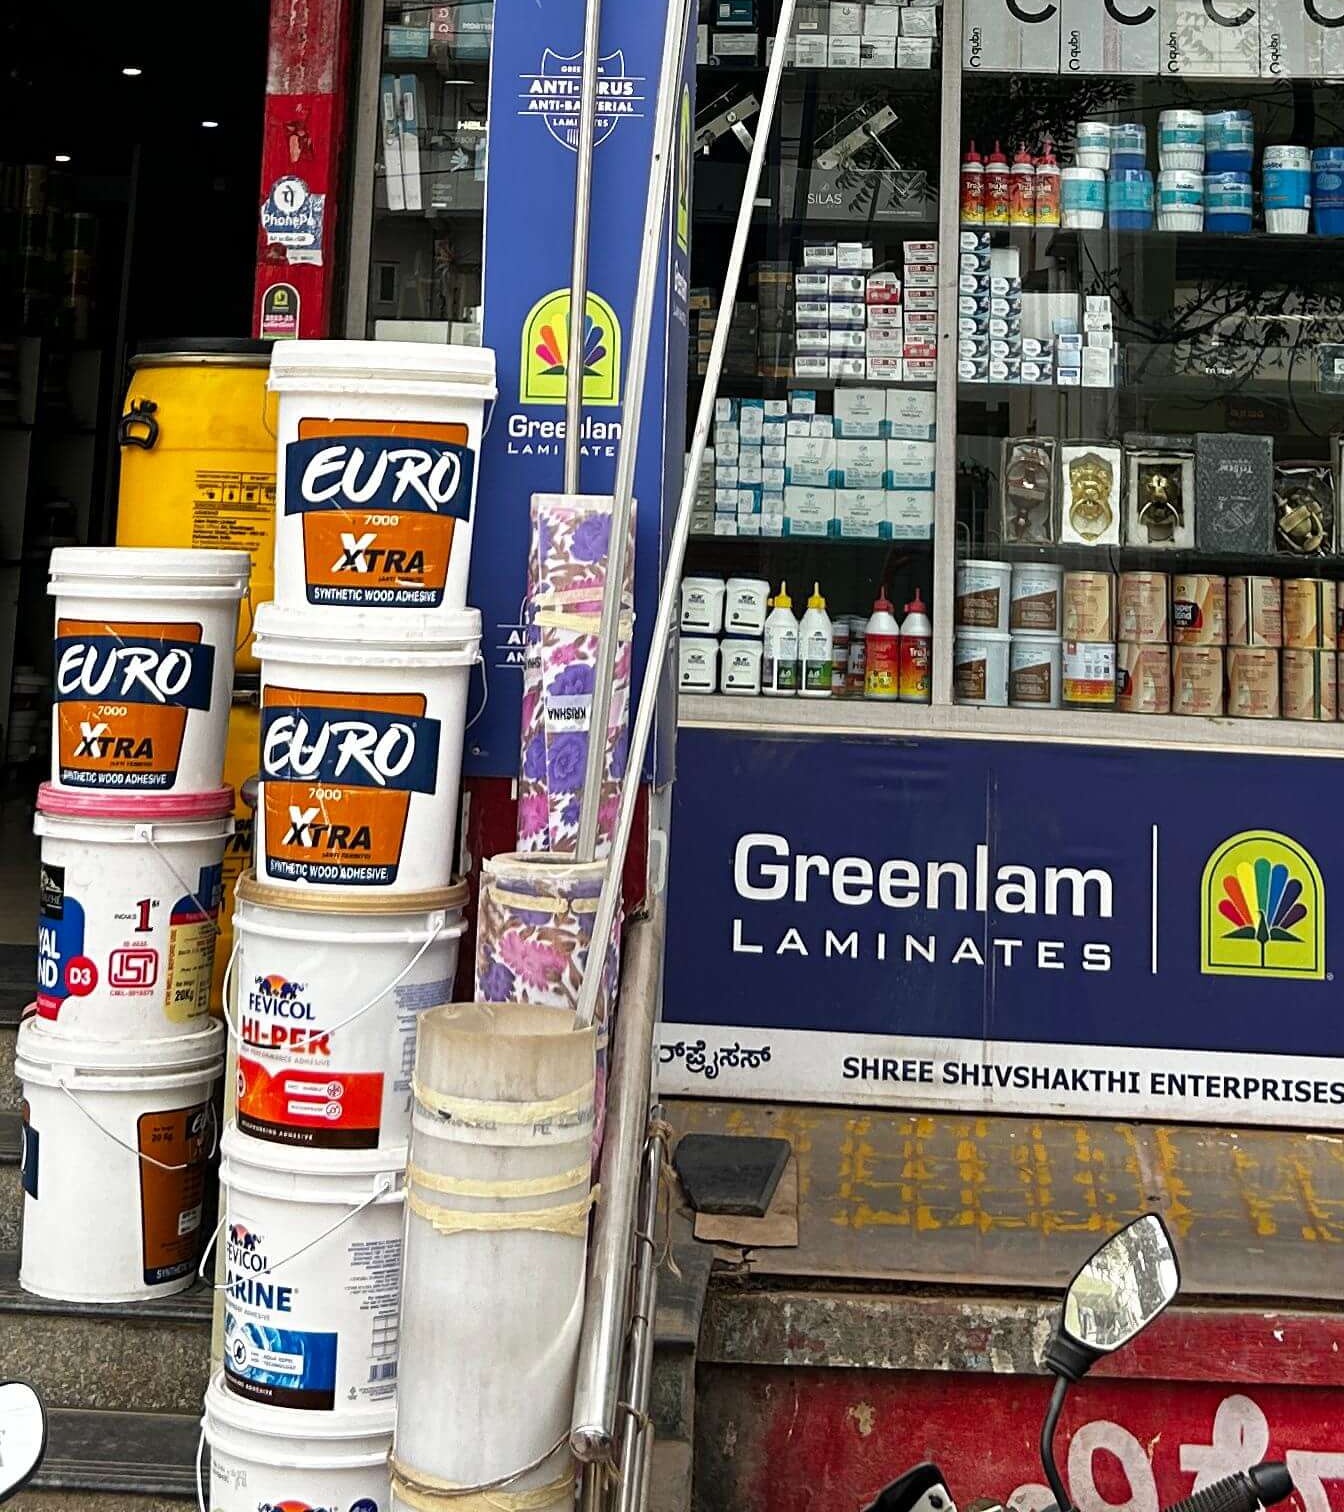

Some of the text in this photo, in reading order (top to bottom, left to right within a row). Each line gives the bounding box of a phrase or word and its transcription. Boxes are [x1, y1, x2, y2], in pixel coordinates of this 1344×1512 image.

[529, 79, 634, 95] ANTI-RUS
[528, 99, 634, 113] ANTI-BAERIAL
[807, 192, 843, 206] SILAS
[508, 414, 622, 440] Greelam
[301, 445, 462, 509] EURO
[364, 515, 400, 527] 7000
[332, 533, 426, 575] XTRA
[313, 587, 437, 604] SYNTHETIC WOOD ADHESIVE
[56, 645, 192, 703] EURO
[97, 706, 128, 717] 7000
[547, 707, 586, 721] KRISHNA
[73, 721, 154, 759] XTRA
[263, 717, 416, 785] EURO
[98, 772, 124, 785] WOOD
[124, 772, 167, 785] ADHESIVE
[308, 788, 343, 801] 7000
[282, 806, 372, 850] XTRA
[270, 859, 388, 882] SYNTHETIC WOOD ADHESIVE
[733, 833, 1114, 918] Greenlam
[732, 919, 1113, 972] LAMINATES
[69, 967, 92, 985] D3
[249, 992, 316, 1021] FEVICOL
[242, 1015, 331, 1055] HI-PER
[842, 1057, 934, 1084] SHREE
[942, 1062, 1141, 1095] SHIVSHAKTHI
